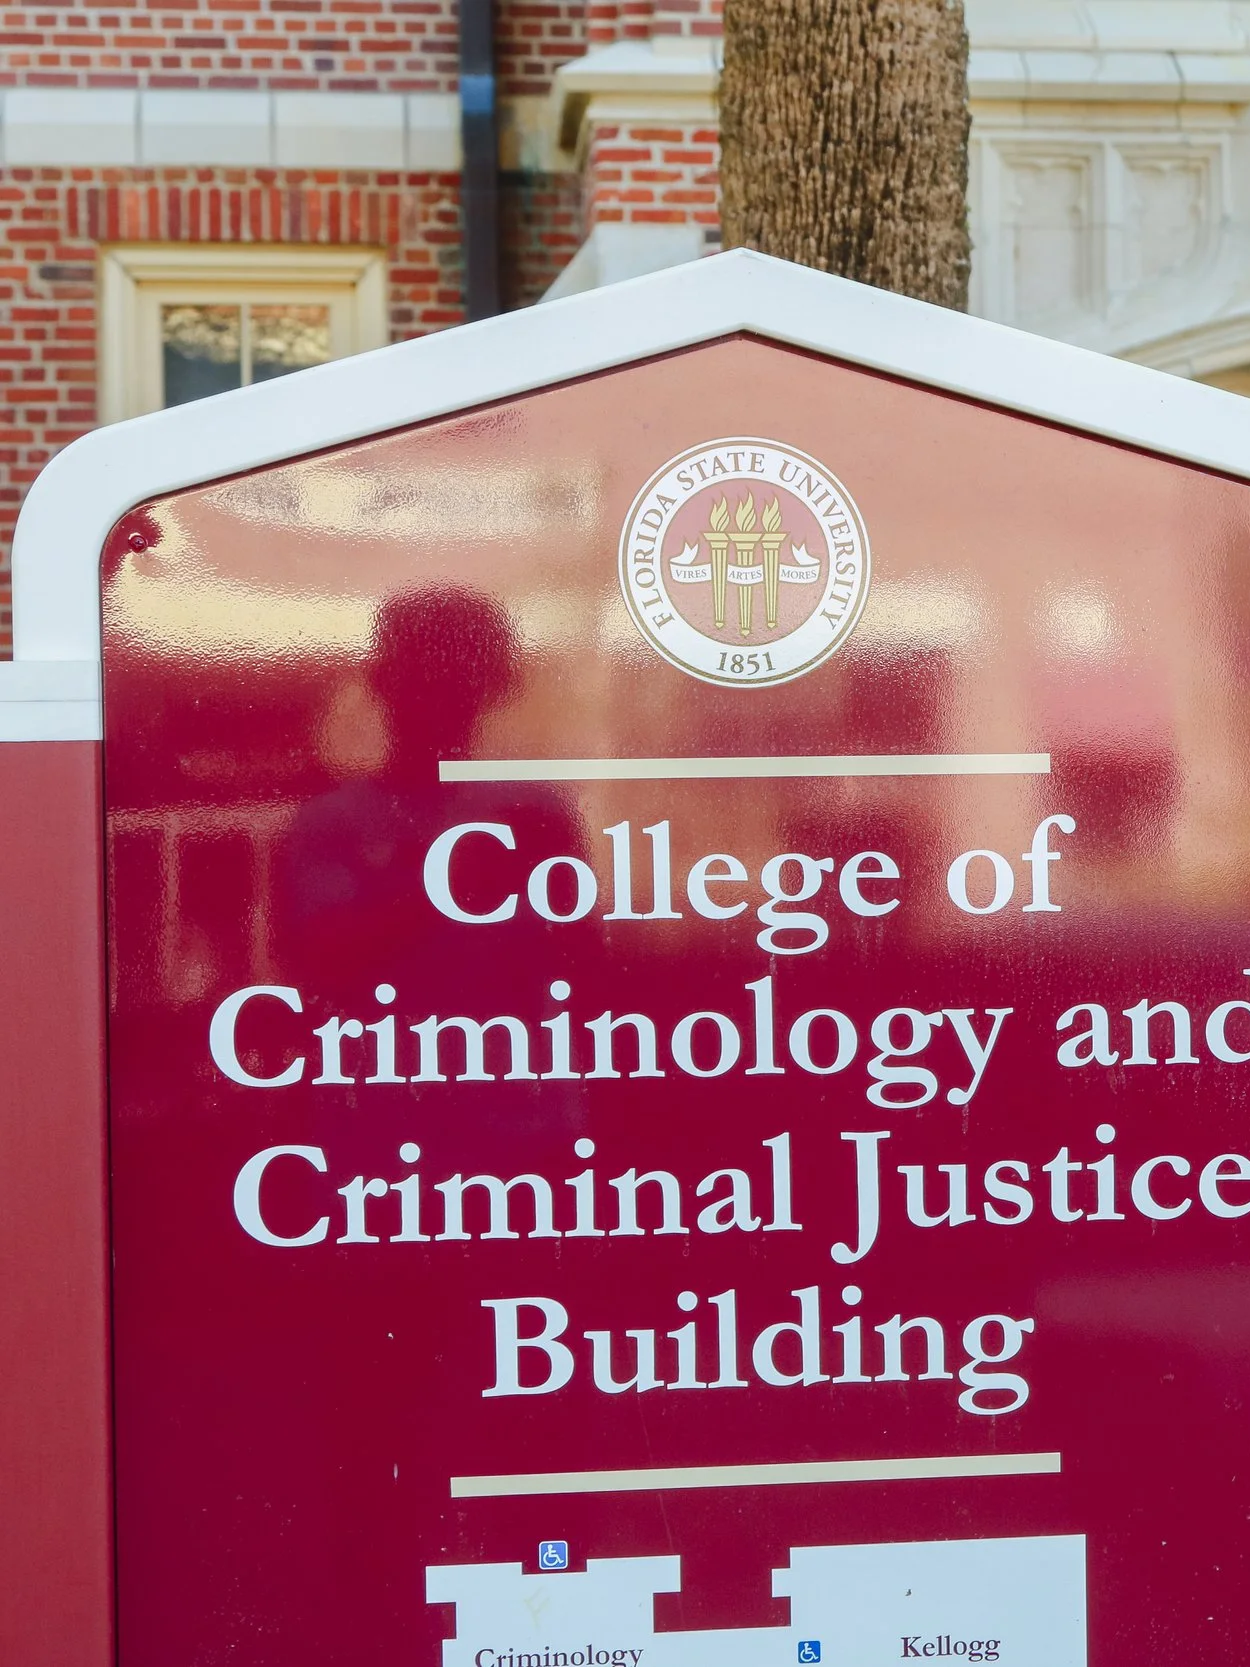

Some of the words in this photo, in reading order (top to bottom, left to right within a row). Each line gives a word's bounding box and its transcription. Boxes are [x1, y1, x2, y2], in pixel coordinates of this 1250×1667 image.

[633, 491, 678, 630] FLORIDA
[676, 451, 765, 491] STATE
[778, 459, 856, 629] UNIVERSITY
[674, 568, 707, 579] VIRES
[728, 569, 762, 580] ARTES
[780, 569, 817, 580] MORES
[716, 651, 776, 676] 1851
[423, 819, 901, 955] College
[946, 813, 1077, 915] of
[209, 975, 1014, 1109] Criminology
[233, 1132, 803, 1247] Criminal
[480, 1285, 1035, 1416] Building
[474, 1644, 644, 1667] Criminology
[900, 1634, 1001, 1663] Kellogg
